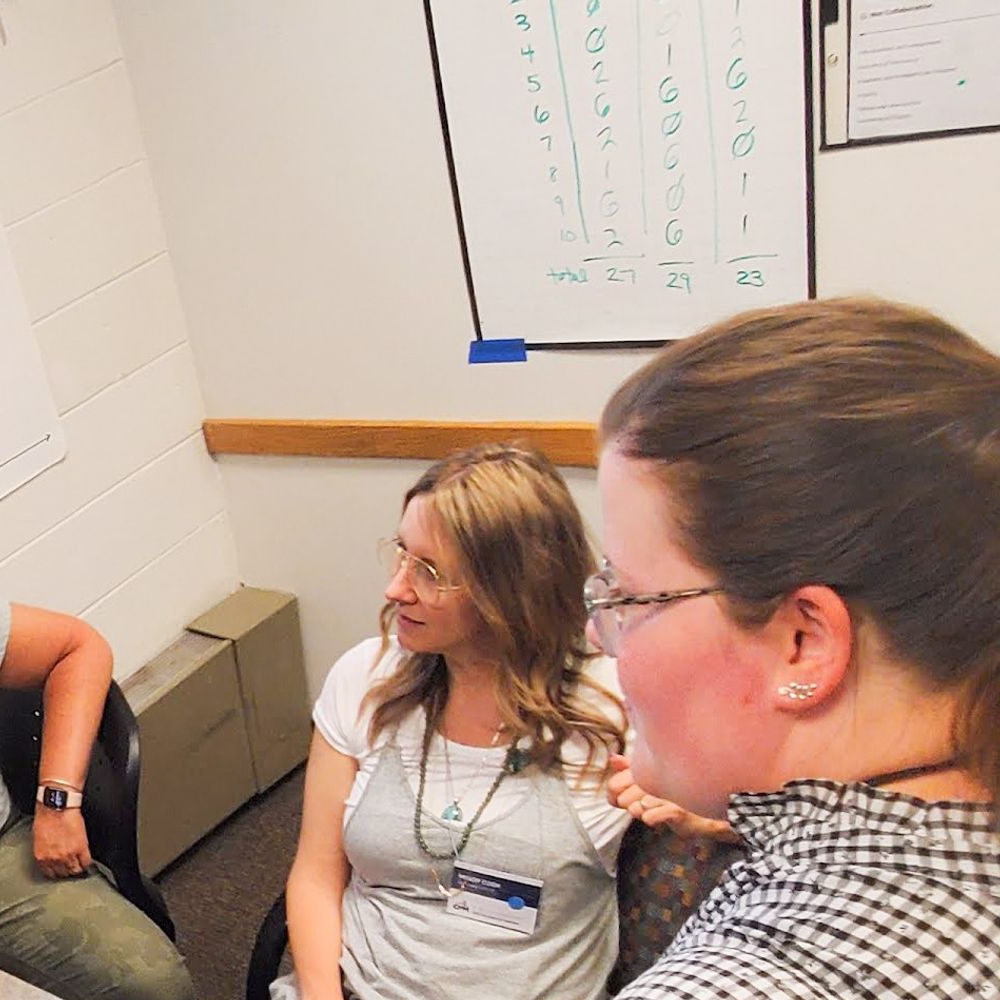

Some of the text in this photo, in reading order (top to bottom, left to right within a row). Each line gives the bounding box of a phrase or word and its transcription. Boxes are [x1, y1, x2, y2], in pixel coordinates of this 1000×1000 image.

[515, 14, 531, 31] 3
[521, 44, 535, 62] 4
[527, 74, 541, 92] 5
[592, 61, 609, 84] 2
[534, 58, 748, 124] 6 6 6 6
[540, 135, 552, 151] 7
[597, 126, 617, 151] 2
[733, 100, 749, 123] 2
[603, 228, 623, 248] 2
[665, 218, 683, 246] 6
[606, 267, 635, 283] 27
[666, 272, 691, 294] 29
[736, 270, 765, 287] 23
